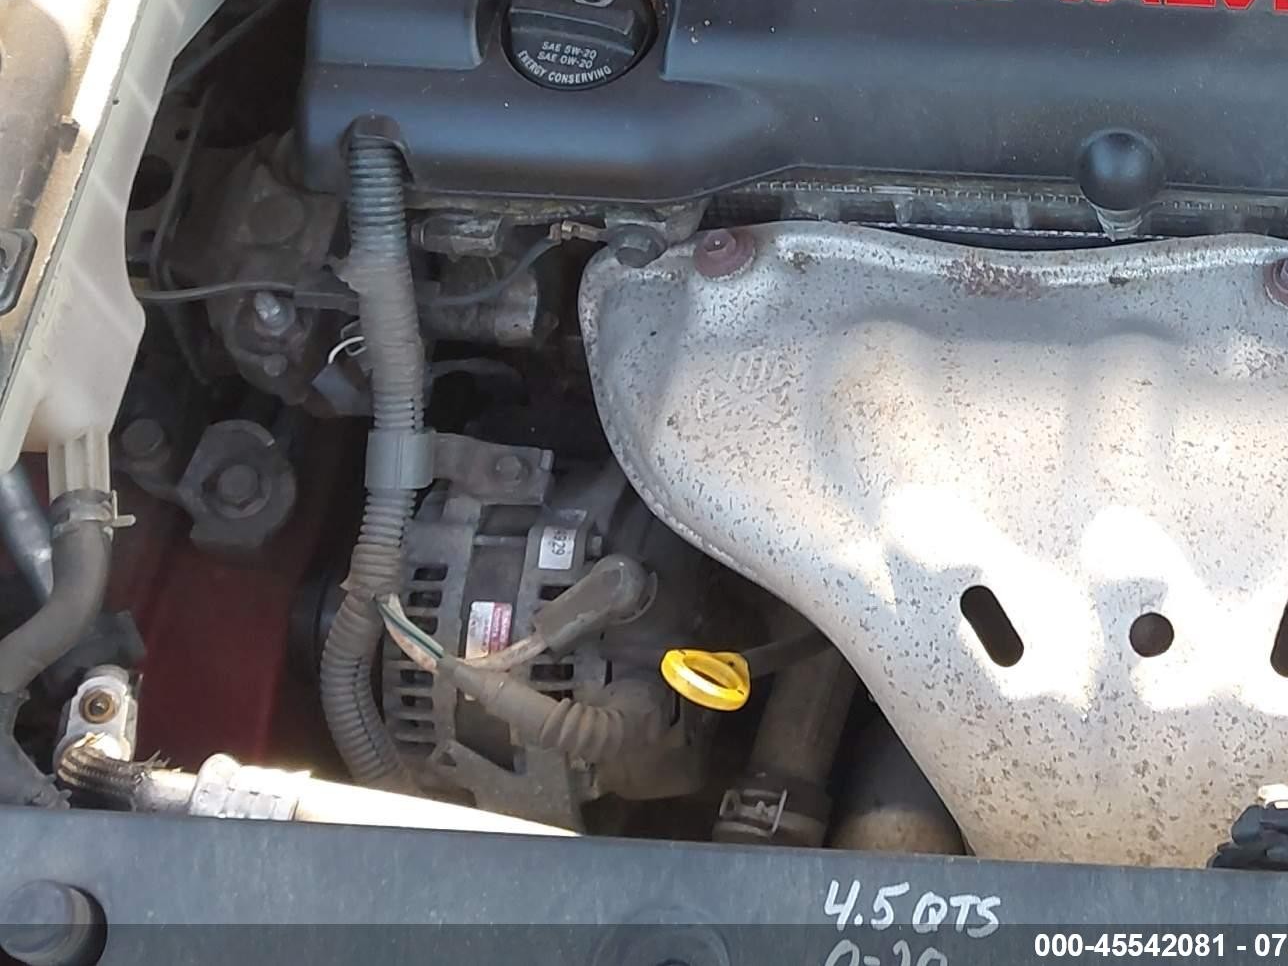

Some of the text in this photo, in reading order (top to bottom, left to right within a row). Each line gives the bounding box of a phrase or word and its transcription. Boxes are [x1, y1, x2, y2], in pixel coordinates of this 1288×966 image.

[537, 51, 593, 69] SAE 0W-20
[542, 41, 598, 61] SAE 5W-20
[517, 49, 613, 84] ENERGY CONSERVING
[824, 879, 1002, 938] 4.5 QTS
